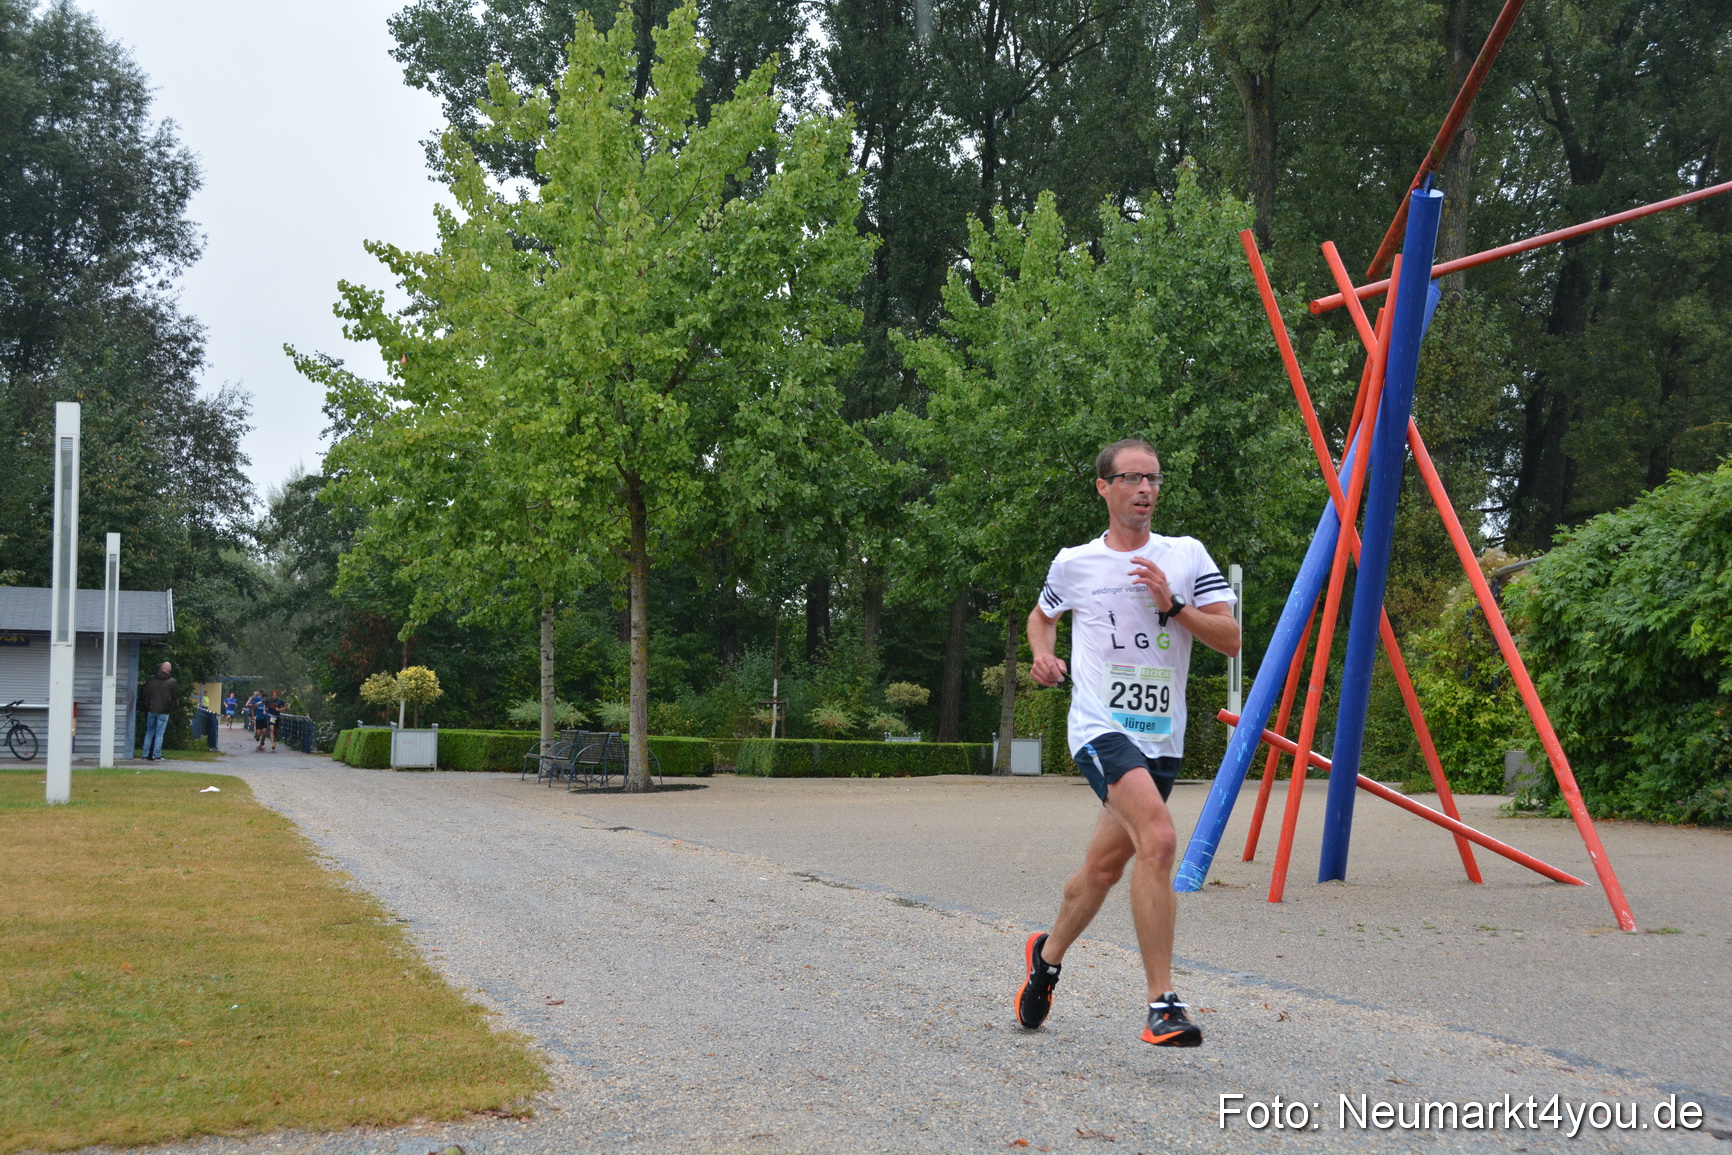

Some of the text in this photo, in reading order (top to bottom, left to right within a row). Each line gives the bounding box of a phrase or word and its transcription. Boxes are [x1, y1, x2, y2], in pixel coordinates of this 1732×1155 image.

[1091, 585, 1149, 596] weidinger versich
[1140, 668, 1171, 679] BOCK
[1109, 681, 1170, 714] 2359
[1122, 717, 1156, 732] Jürgen
